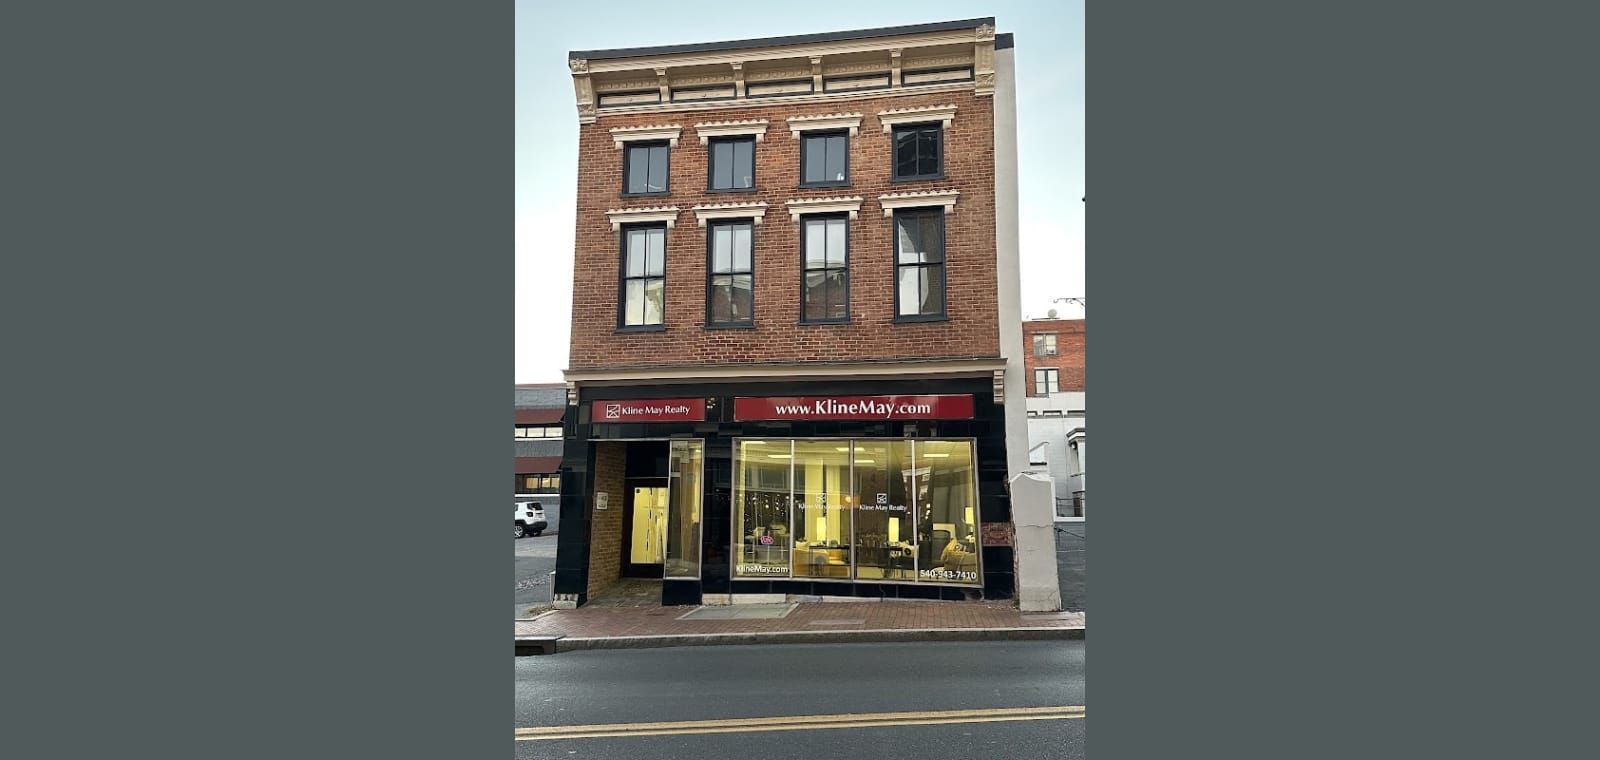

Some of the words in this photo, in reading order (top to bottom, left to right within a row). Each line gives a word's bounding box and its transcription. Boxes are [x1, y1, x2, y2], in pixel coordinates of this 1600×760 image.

[622, 406, 643, 415] Kline
[645, 406, 664, 416] May
[665, 404, 690, 415] Realty
[775, 399, 931, 419] www.KlineMay.com
[736, 564, 789, 574] KlineMay.com
[920, 569, 978, 580] 540-943-7410
